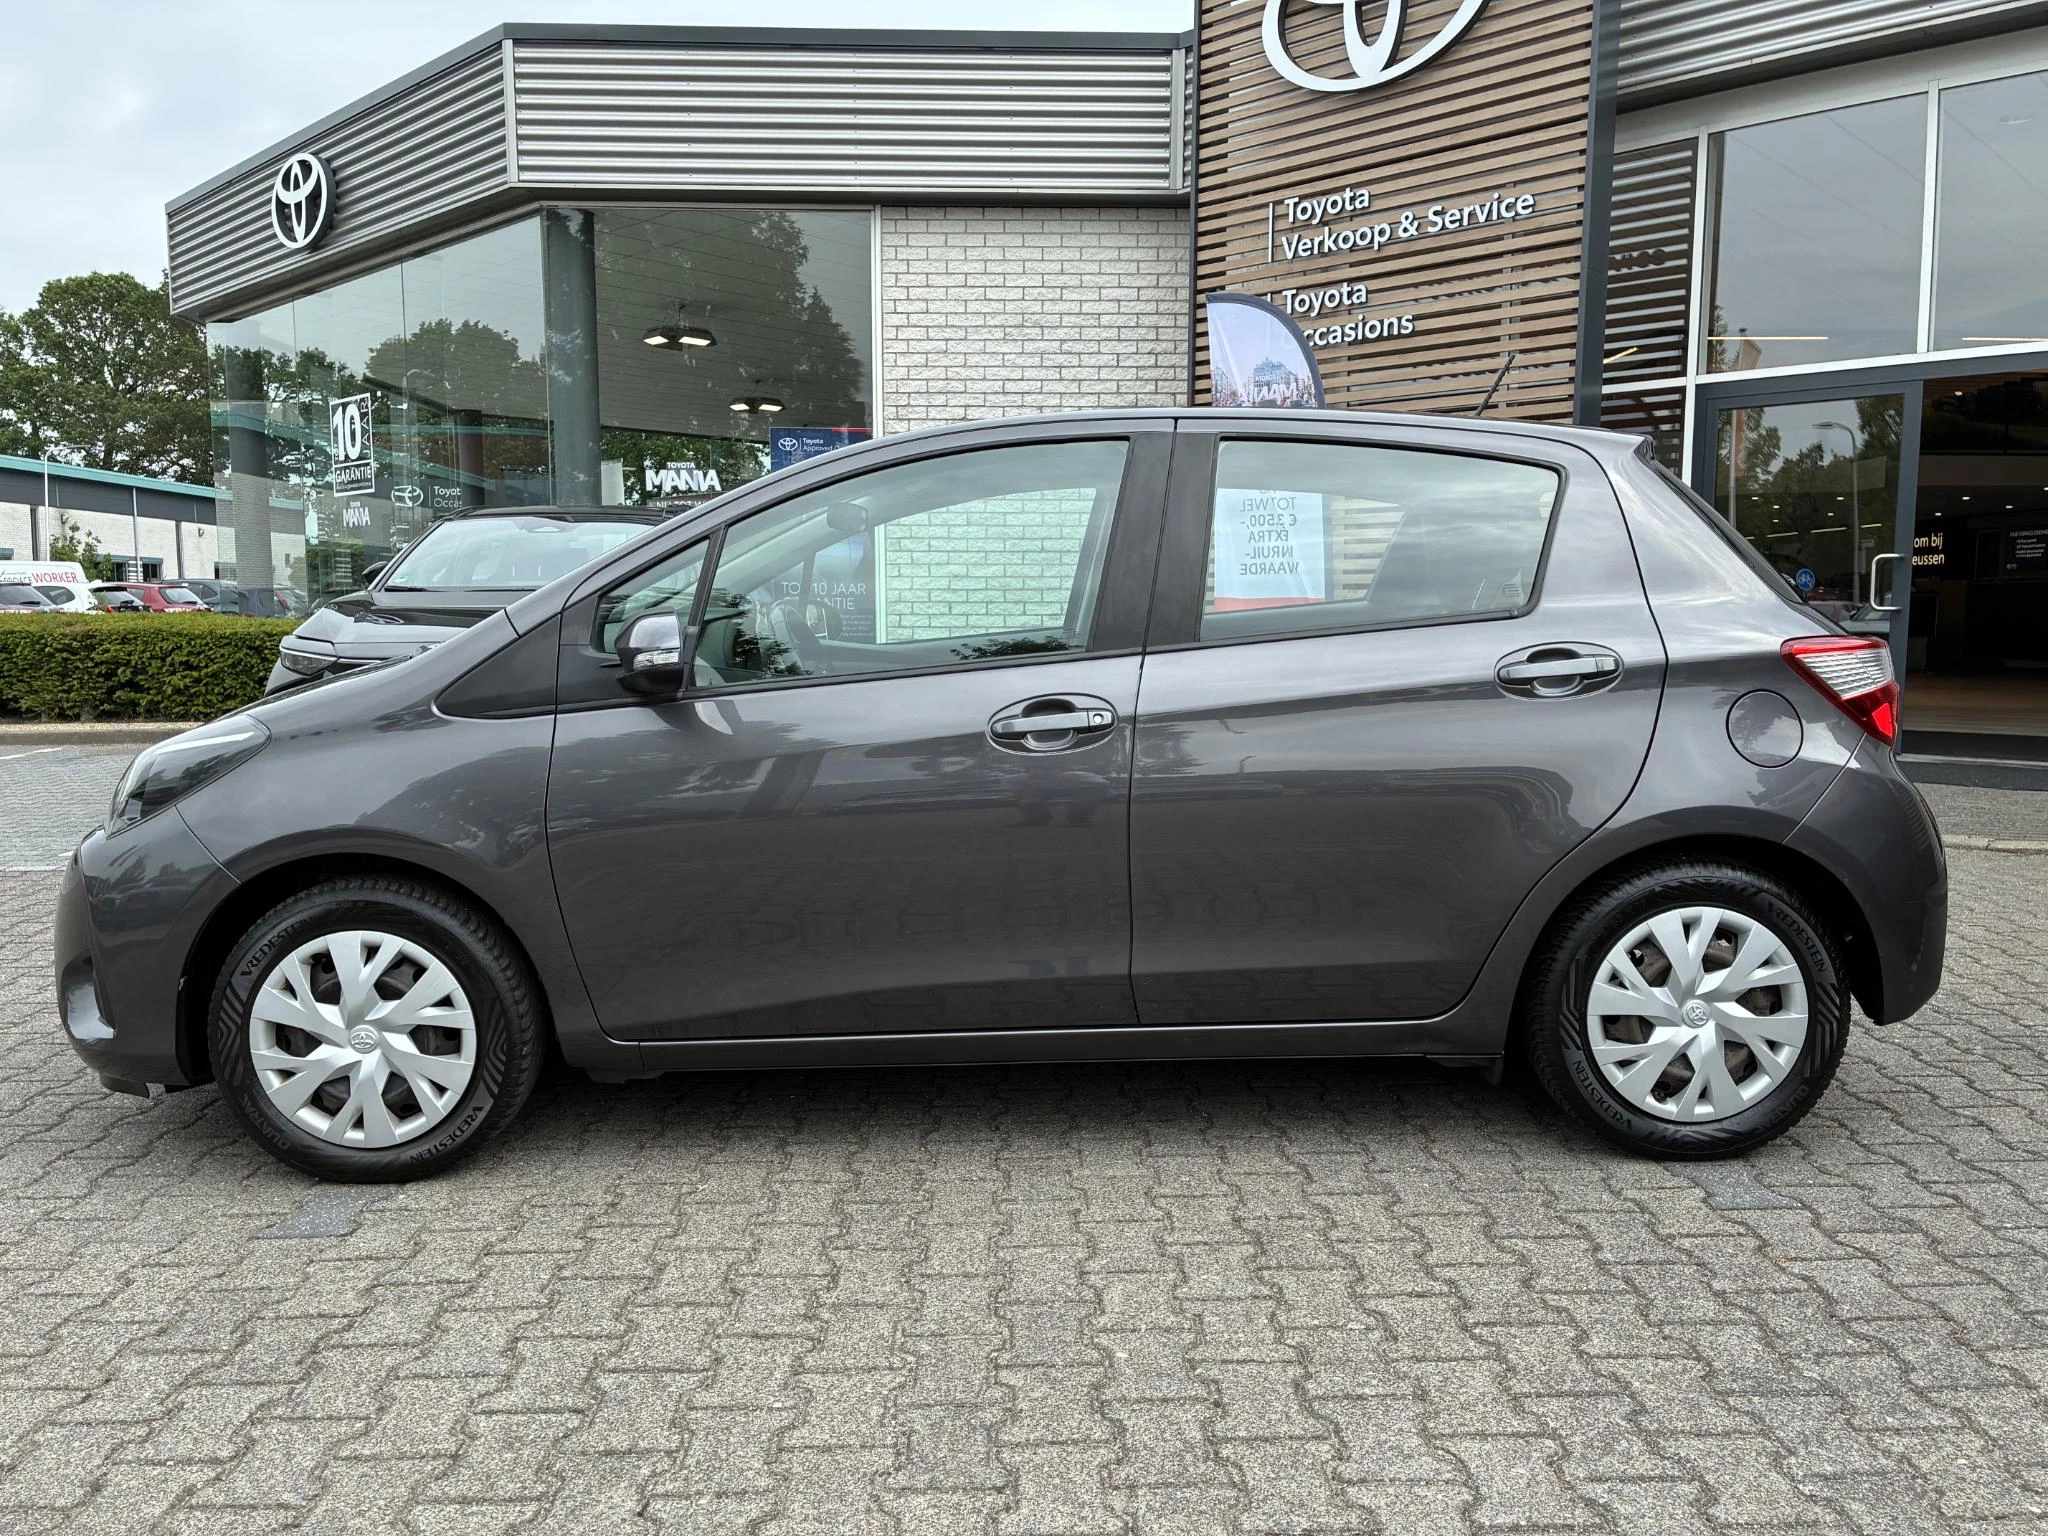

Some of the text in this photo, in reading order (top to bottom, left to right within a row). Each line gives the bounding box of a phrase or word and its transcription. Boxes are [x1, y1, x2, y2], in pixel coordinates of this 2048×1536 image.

[1283, 187, 1371, 224] Toyota
[1281, 192, 1536, 261] Verkoop & Service
[1281, 281, 1369, 317] Toyota
[1303, 314, 1415, 348] ccasions
[333, 403, 362, 462] 10
[360, 400, 371, 458] JAAR
[335, 465, 372, 484] GARANTIE
[645, 469, 722, 492] MANIA
[433, 486, 462, 498] Toyot
[343, 506, 371, 528] MANIA
[1913, 532, 1944, 550] om bij
[1912, 553, 1945, 566] eussen
[32, 572, 79, 583] WORKER
[781, 582, 801, 595] TO
[831, 582, 867, 596] JAAR
[1767, 901, 1828, 972] VREDESTEIN
[1572, 1060, 1632, 1130] VREDESTEIN
[409, 1105, 485, 1163] VREDESTEIN
